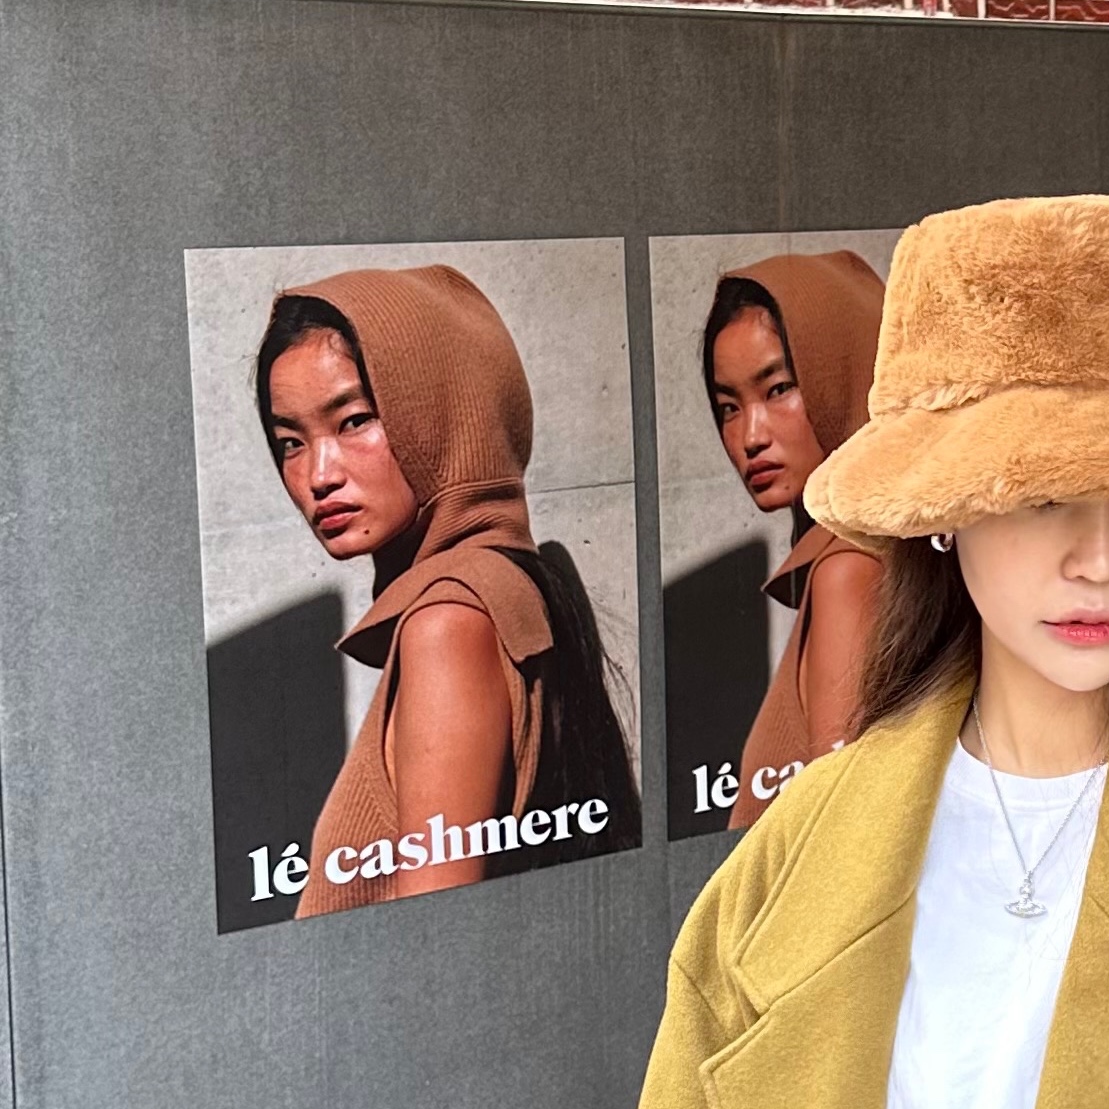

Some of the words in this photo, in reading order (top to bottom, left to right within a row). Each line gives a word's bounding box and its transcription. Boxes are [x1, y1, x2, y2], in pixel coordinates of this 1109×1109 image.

[691, 762, 740, 813] lé
[248, 842, 310, 902] lé
[324, 798, 609, 884] cashmere
